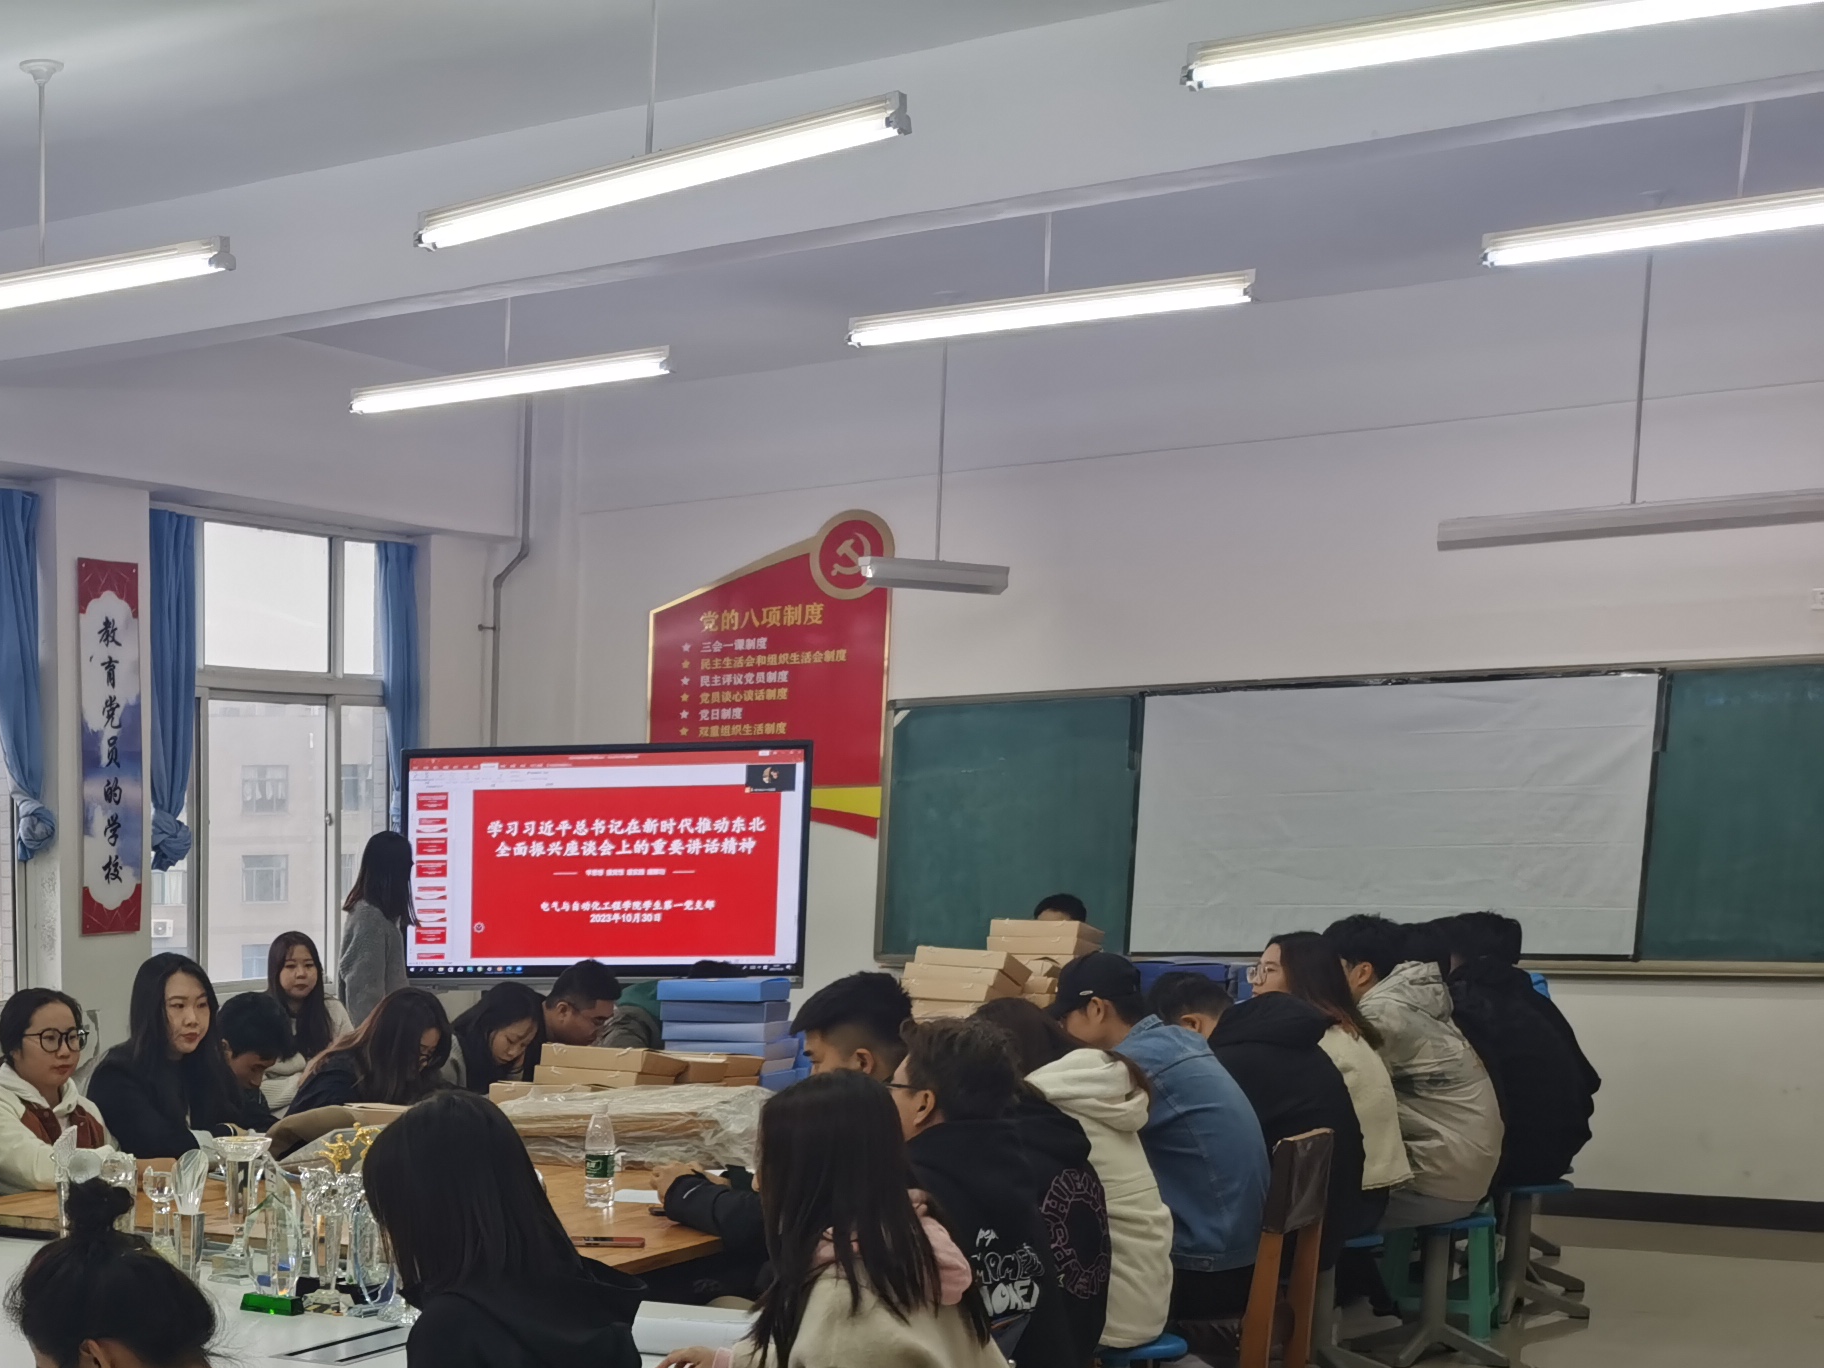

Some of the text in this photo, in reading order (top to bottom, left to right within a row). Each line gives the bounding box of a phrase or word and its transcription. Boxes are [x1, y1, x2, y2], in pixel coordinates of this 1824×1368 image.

[699, 602, 825, 632] 党的八项制度
[700, 637, 768, 653] 三会一课制度
[700, 649, 847, 671] 民主生活会和组织生活会制度
[700, 670, 790, 687] 民主评议党员制度
[699, 687, 789, 704] 党员谈心谈话制度
[699, 707, 743, 721] 党日制度
[698, 722, 787, 738] 双重组织生活制度
[98, 617, 123, 884] 教育党员的学校
[486, 816, 767, 839] 学习习近平总书记在新时代推动东北
[495, 837, 757, 858] 全面振兴座谈会上的重要讲话精神
[589, 912, 663, 924] 2023年10月30日
